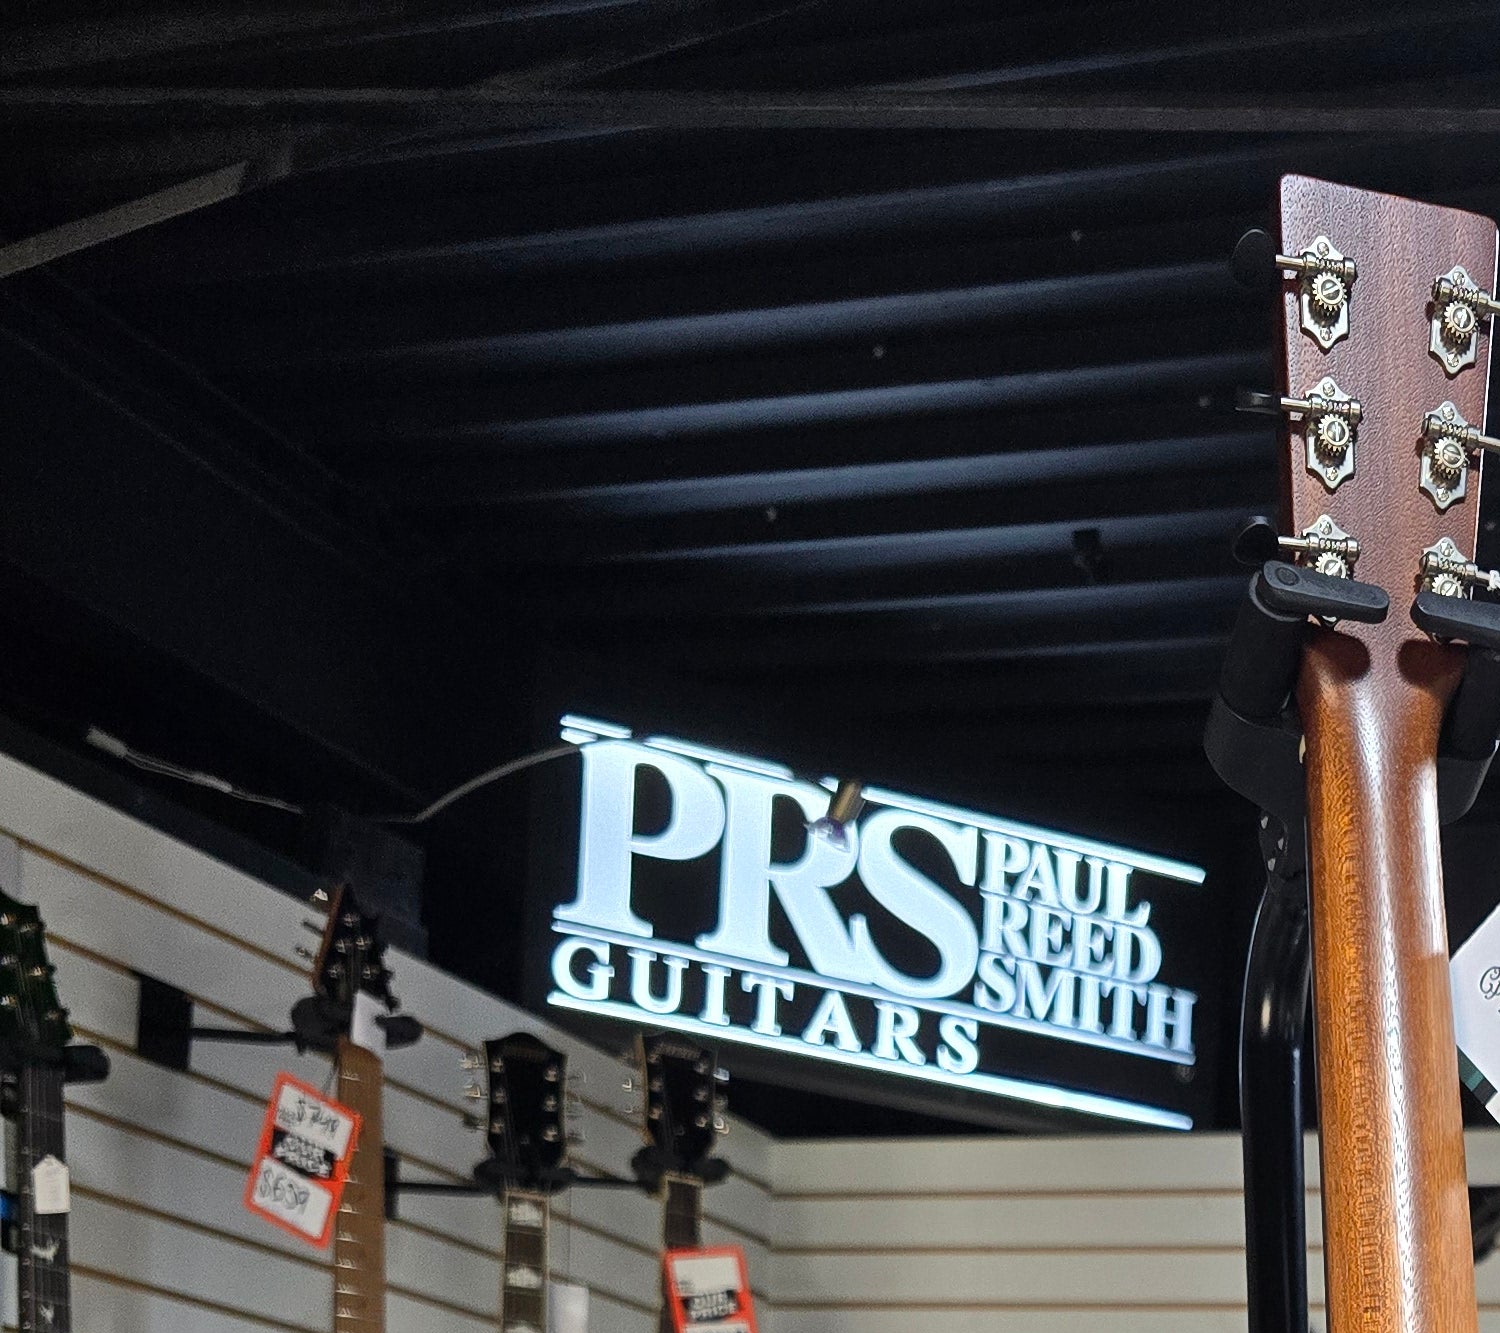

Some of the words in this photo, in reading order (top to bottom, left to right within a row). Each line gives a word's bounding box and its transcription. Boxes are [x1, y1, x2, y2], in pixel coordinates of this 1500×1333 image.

[552, 741, 979, 999] PRS
[979, 828, 1152, 928] PAUL
[979, 892, 1162, 985] REED
[551, 937, 980, 1074] GUITARS
[976, 951, 1197, 1054] SMITH
